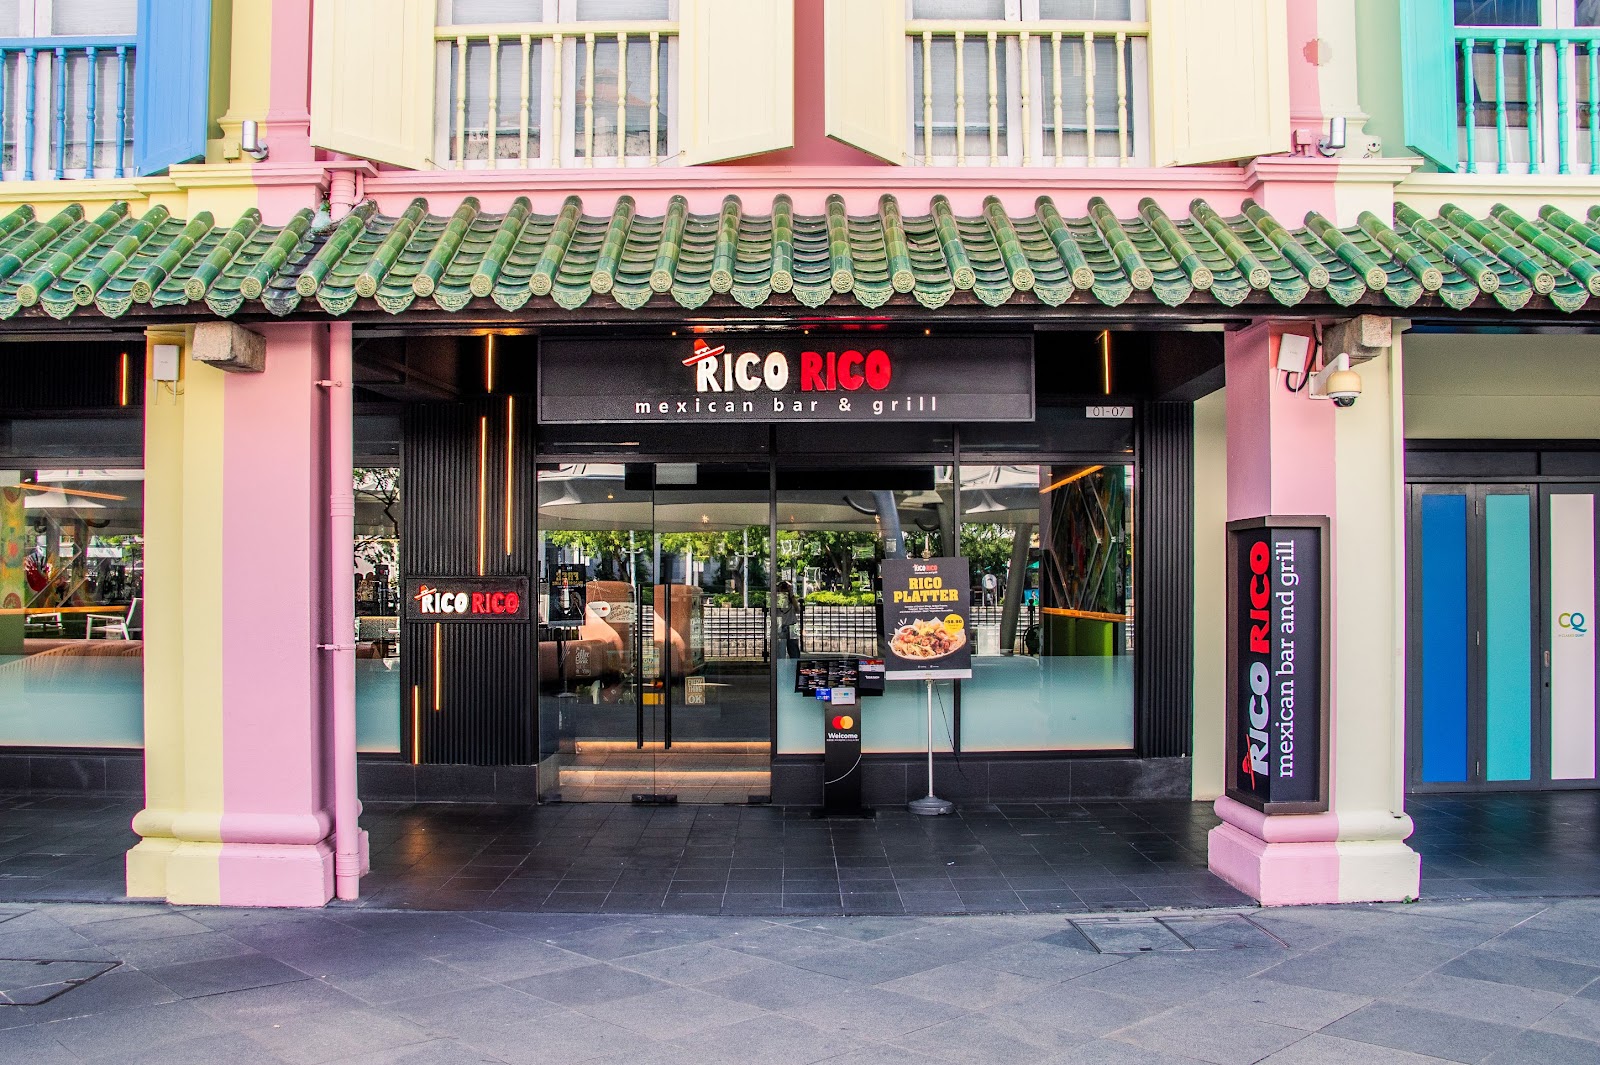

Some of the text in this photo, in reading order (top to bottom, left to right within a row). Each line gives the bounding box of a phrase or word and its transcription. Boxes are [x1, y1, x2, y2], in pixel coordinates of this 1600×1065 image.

[696, 349, 892, 393] RICO RICO
[634, 397, 937, 415] mexican bar & grill
[1093, 406, 1126, 417] 01-07
[908, 576, 942, 590] RICO
[420, 591, 520, 614] RICO RICO
[893, 589, 959, 603] PLATTER
[1558, 612, 1588, 633] CQ
[1249, 541, 1270, 776] RICO RICO
[1274, 540, 1299, 778] mexican bar and grill
[688, 695, 703, 704] OK
